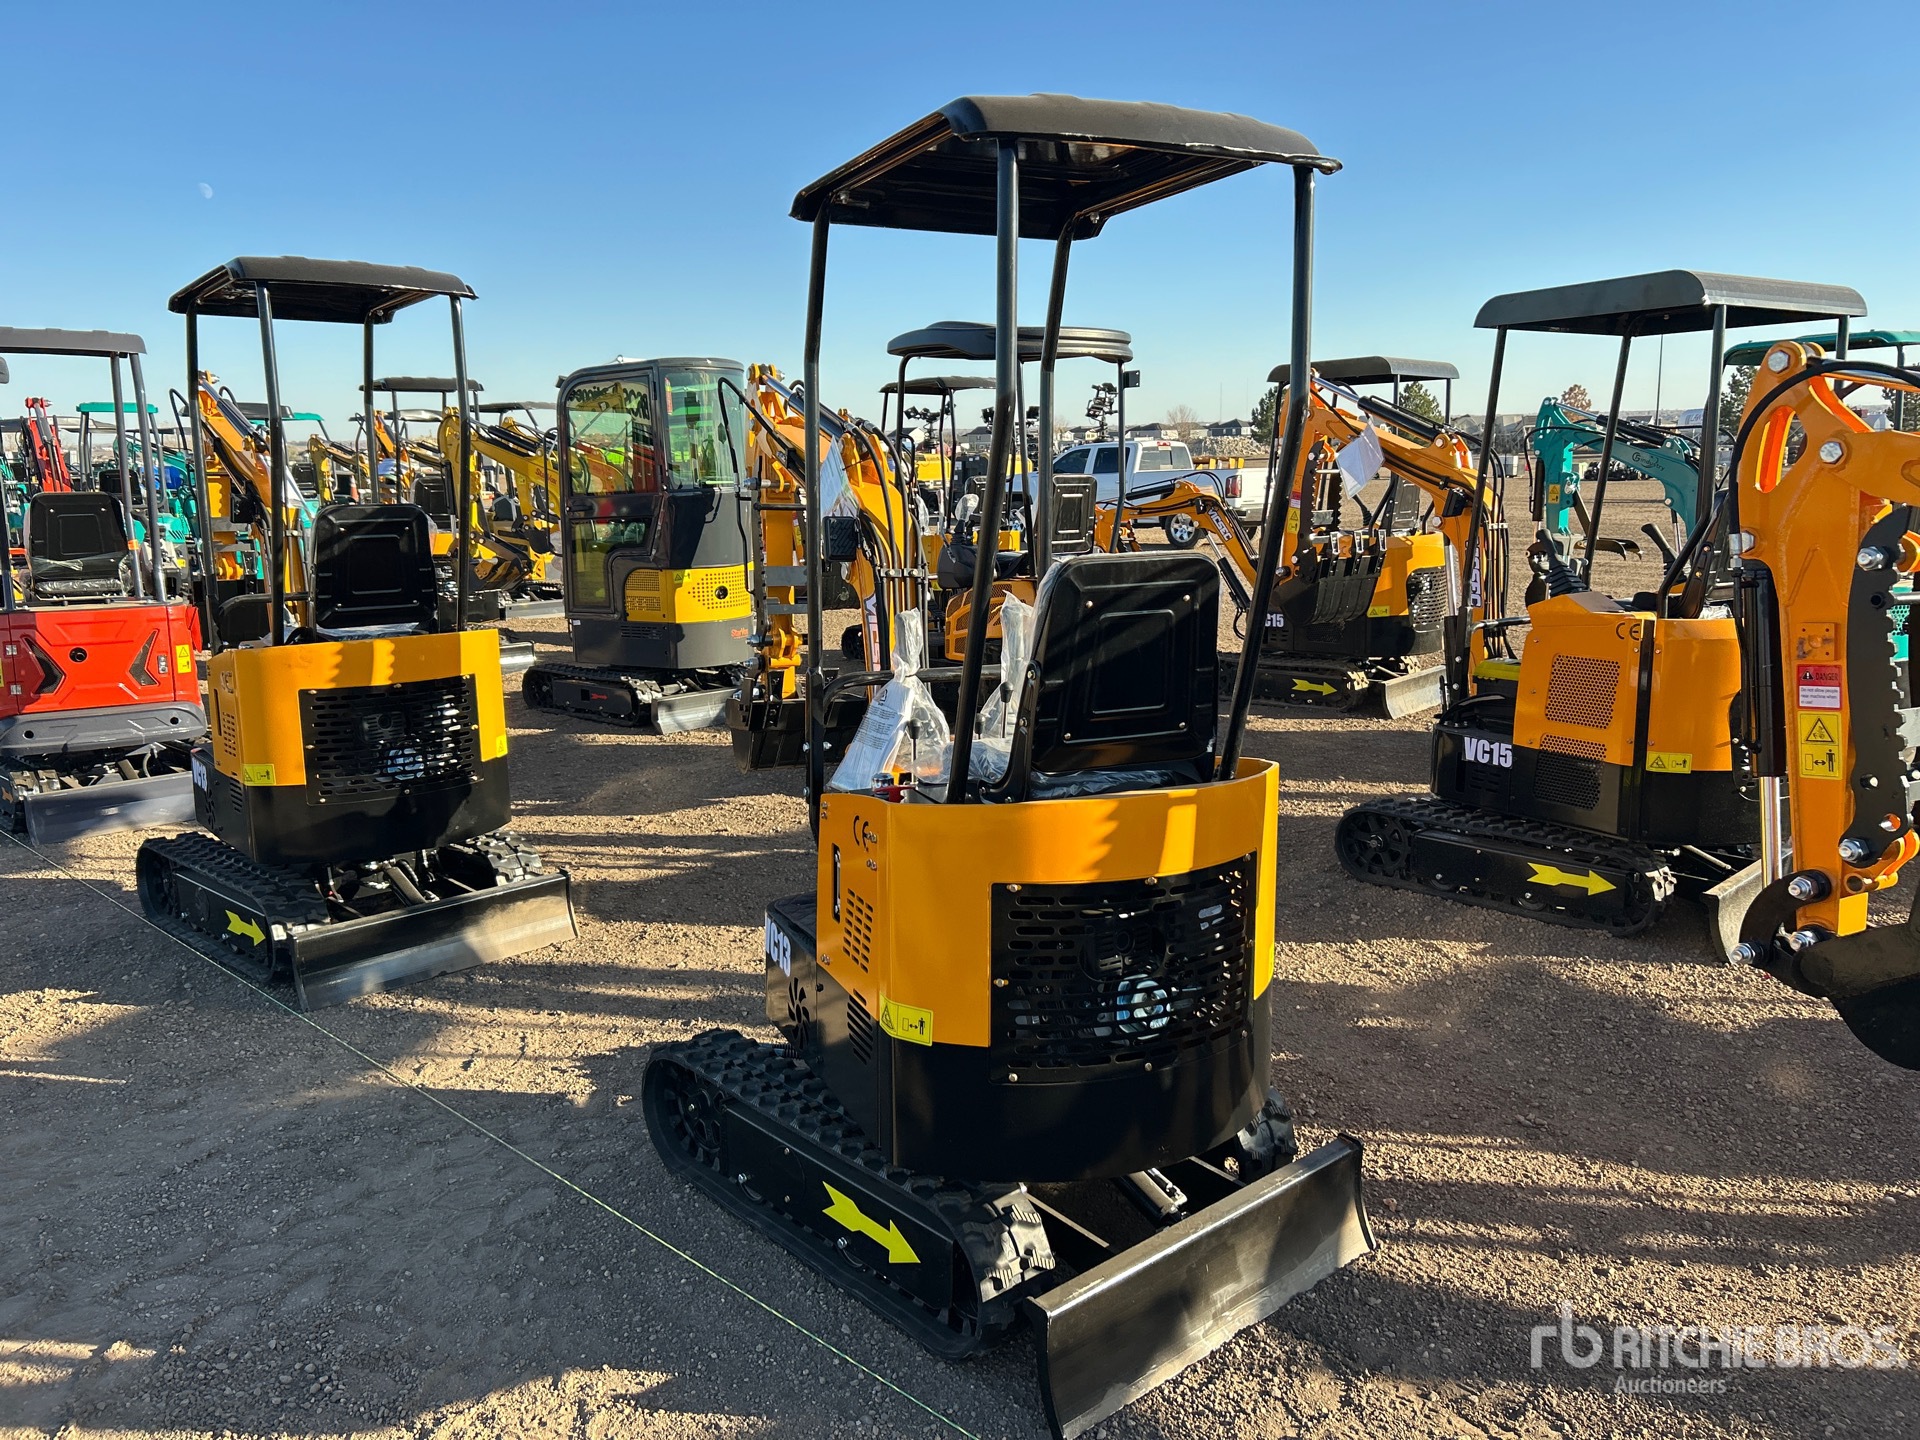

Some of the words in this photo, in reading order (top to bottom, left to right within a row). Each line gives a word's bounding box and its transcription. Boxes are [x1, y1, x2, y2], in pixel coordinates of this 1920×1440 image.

[1264, 613, 1284, 628] C15
[1815, 672, 1838, 681] DANGER
[1464, 736, 1512, 768] VC15
